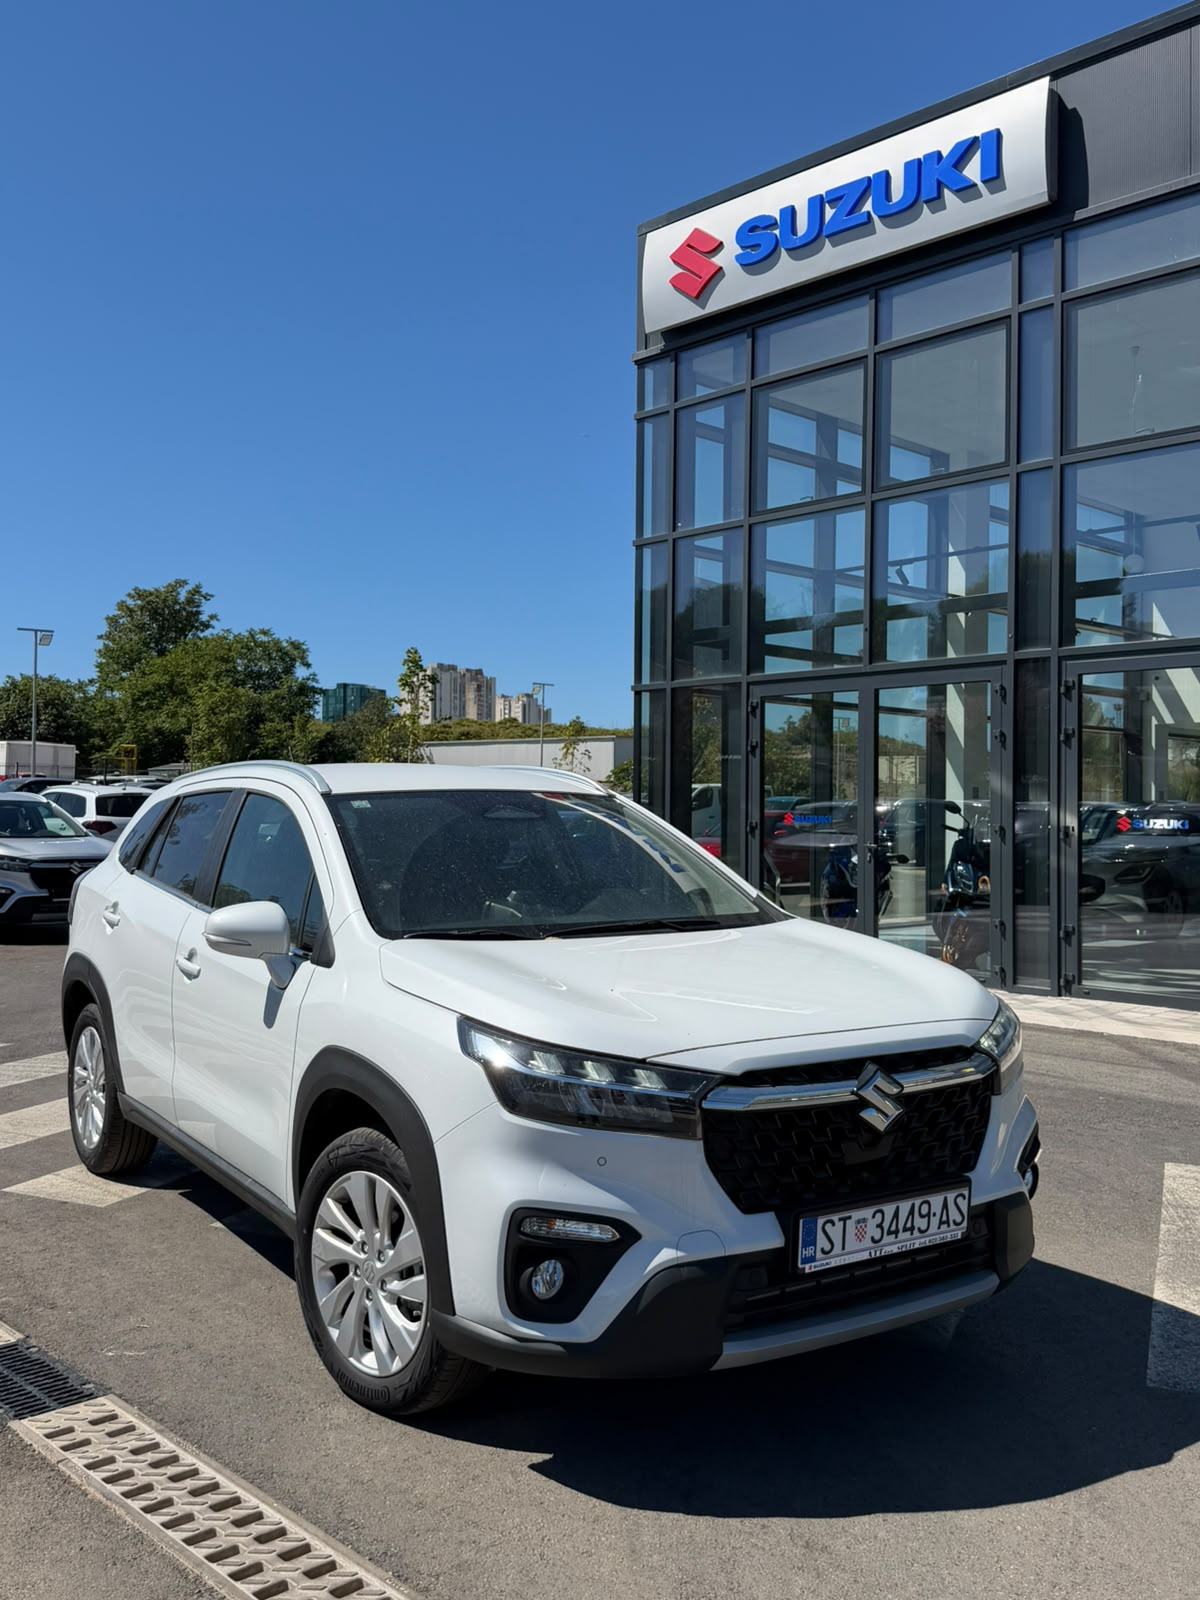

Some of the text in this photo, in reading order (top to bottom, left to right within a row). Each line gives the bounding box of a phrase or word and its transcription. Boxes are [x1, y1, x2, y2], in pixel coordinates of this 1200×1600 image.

[734, 127, 1001, 267] SUZUKI
[794, 815, 833, 825] SUZUKI
[1132, 818, 1190, 831] SUZUKI
[820, 1215, 853, 1255] ST
[802, 1246, 816, 1259] HR
